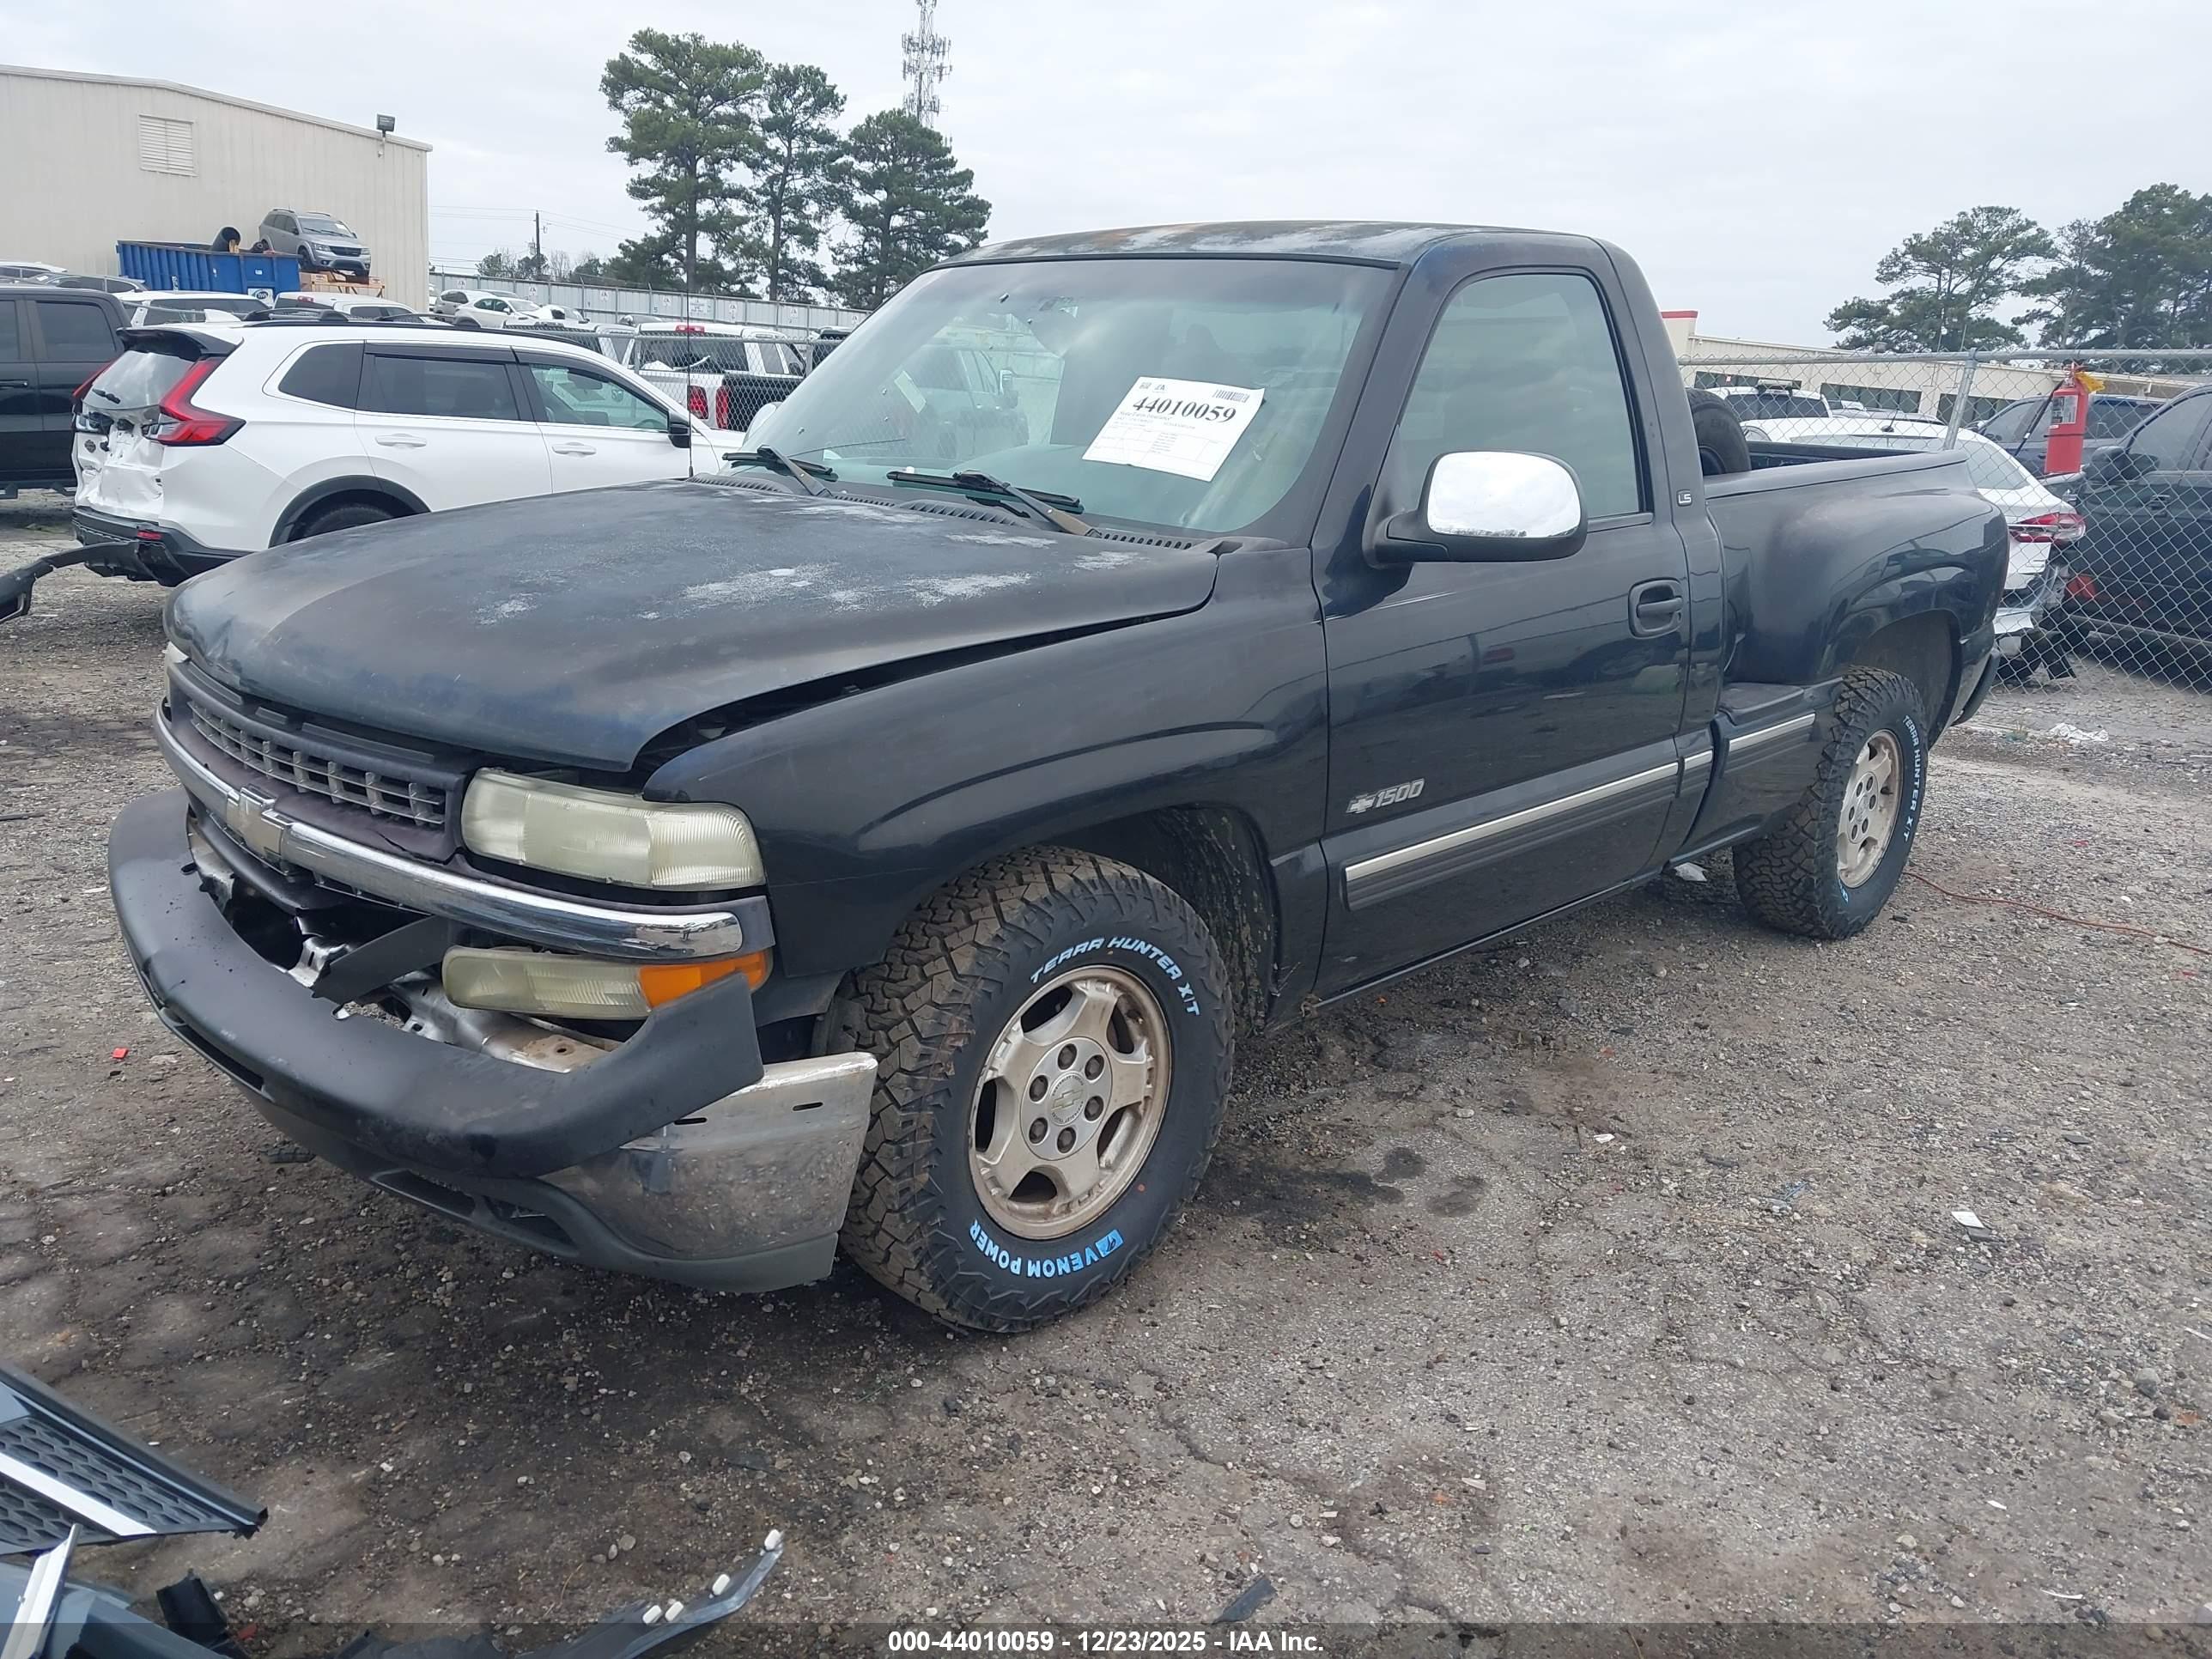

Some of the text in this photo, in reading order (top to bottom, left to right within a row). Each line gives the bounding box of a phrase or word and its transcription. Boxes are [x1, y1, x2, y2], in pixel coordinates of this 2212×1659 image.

[1133, 396, 1237, 423] 44010059
[1678, 493, 1692, 504] LS
[1902, 714, 1920, 746] TERRA
[1374, 778, 1425, 808] 1500
[1910, 749, 1921, 811] HUNTER
[1030, 937, 1105, 984] TERRA
[1107, 936, 1183, 981] HUNTER
[969, 1218, 1100, 1278] VENOM POWER
